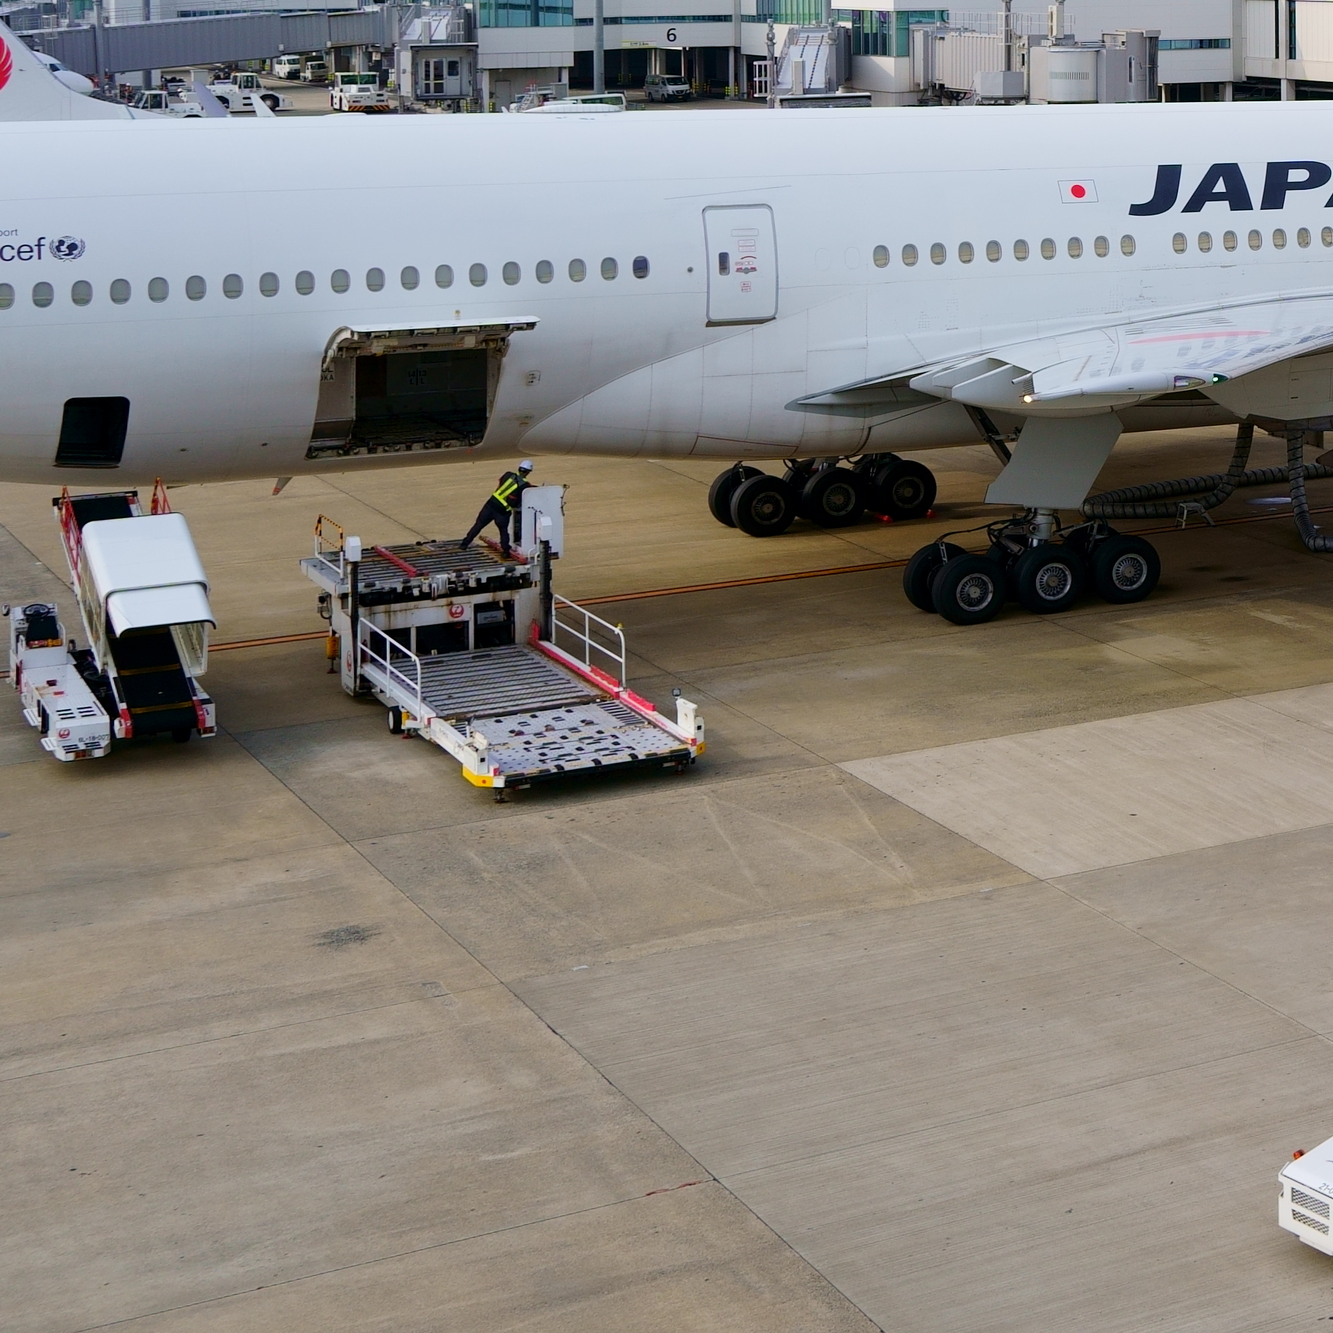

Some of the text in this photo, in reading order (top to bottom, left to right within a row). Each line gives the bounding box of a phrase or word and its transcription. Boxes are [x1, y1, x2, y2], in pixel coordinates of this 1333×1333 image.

[666, 28, 677, 42] 6
[0, 229, 18, 237] ort
[0, 237, 46, 262] cef
